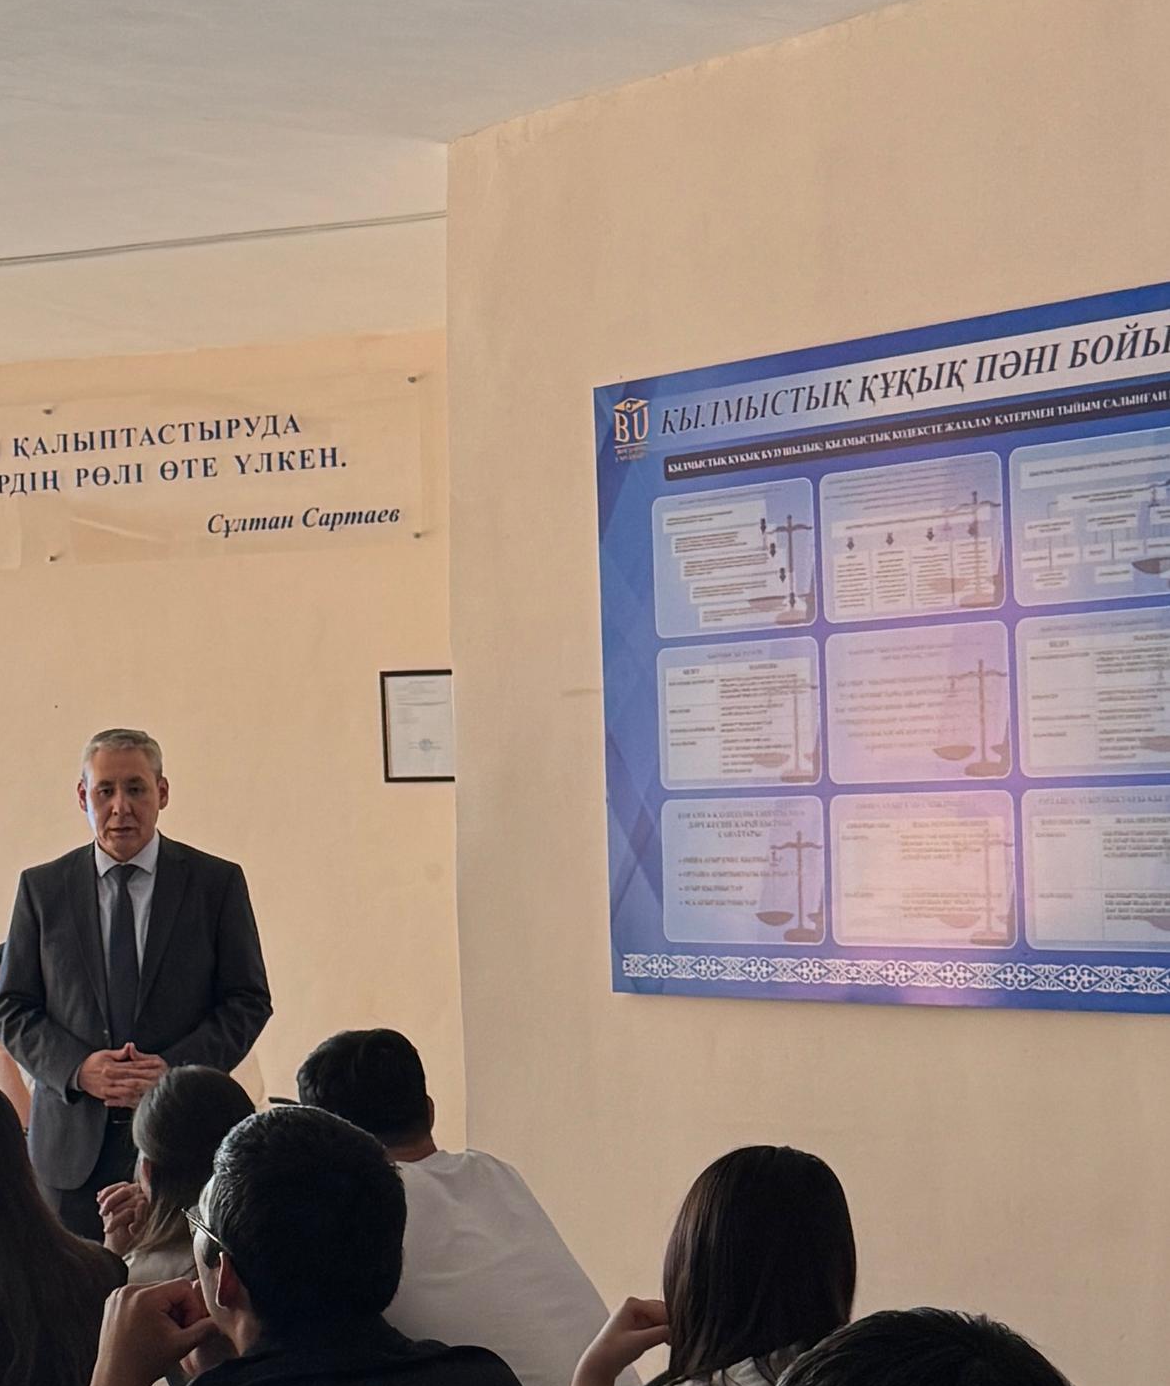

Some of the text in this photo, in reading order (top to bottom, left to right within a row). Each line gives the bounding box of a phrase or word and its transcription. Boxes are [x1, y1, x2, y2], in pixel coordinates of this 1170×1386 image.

[660, 379, 852, 438] ҚЫЛМЫСТЫҚ
[858, 359, 968, 404] ҚҰҚЫҚ
[973, 342, 1062, 384] ПӘНІ
[13, 413, 302, 459] ҚАЛЫПТАСТЫРУДА
[76, 463, 144, 488] РӨЛІ
[159, 457, 218, 481] ӨТЕ
[234, 446, 347, 475] ҮЛКЕН.
[207, 506, 400, 538] Сұлтан Сартаев
